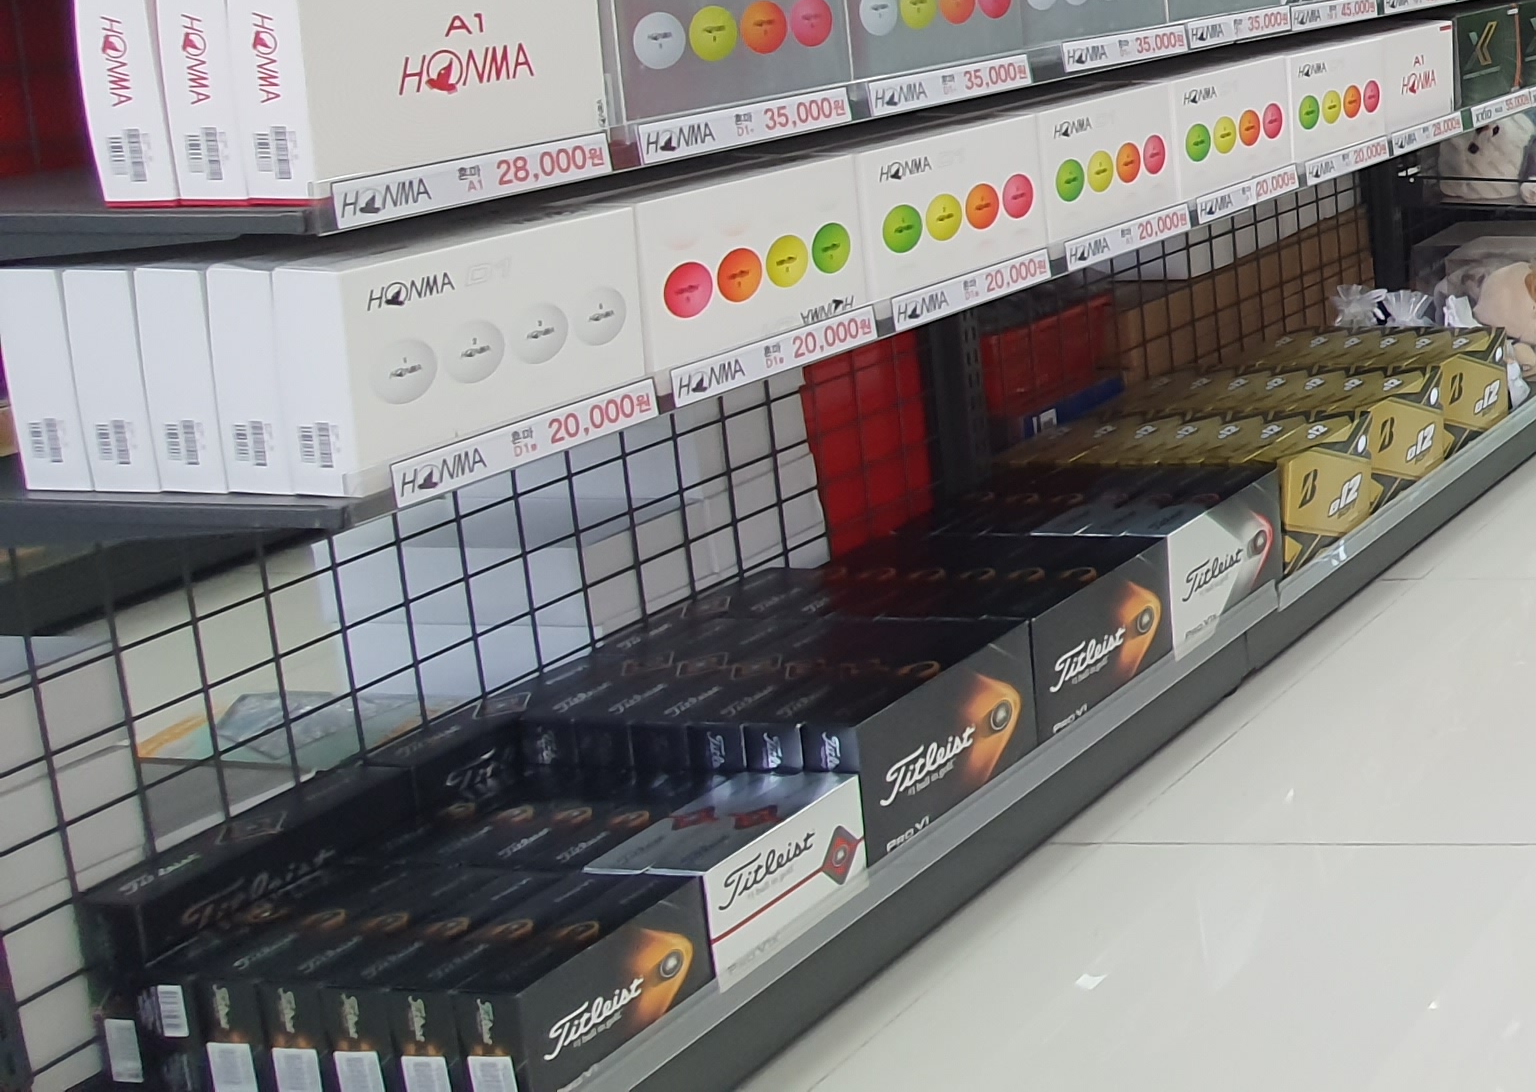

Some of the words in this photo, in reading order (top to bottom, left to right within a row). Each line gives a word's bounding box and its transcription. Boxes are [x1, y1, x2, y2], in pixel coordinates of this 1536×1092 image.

[444, 12, 486, 38] A1
[1247, 11, 1289, 32] 35,000원
[1340, 0, 1376, 18] 45,000원
[99, 14, 133, 108] HONMA
[180, 13, 211, 106] HONMA
[251, 12, 281, 104] HONMA
[399, 42, 535, 96] HONMA
[1067, 43, 1108, 65] HONMA
[1135, 31, 1185, 55] 35,000원
[1413, 55, 1425, 67] A1
[874, 81, 928, 108] HONMA
[963, 60, 1028, 91] 35,000원
[1183, 86, 1217, 105] HONMA
[1401, 69, 1437, 96] HONMA
[645, 120, 716, 156] HONMA
[763, 96, 846, 132] 35,000원
[1053, 117, 1092, 139] HONMA
[879, 154, 933, 183] HONMA
[1353, 144, 1387, 165] 20,000원
[340, 177, 433, 220] HONMA
[496, 143, 605, 188] 28,000원
[1255, 172, 1297, 198] 20,000원
[1138, 210, 1188, 240] 20,000원
[366, 271, 456, 312] HONMA
[896, 292, 951, 324] HONMA
[985, 258, 1047, 294] 20,000원
[677, 358, 746, 398] HONMA
[792, 317, 872, 360] 20,000원
[400, 445, 488, 498] HONMA
[547, 392, 653, 445] 20,000원
[1181, 546, 1244, 603] Titleist
[1049, 624, 1127, 693] Titleist
[880, 723, 976, 808] Titleist
[886, 826, 914, 853] PRO
[719, 831, 815, 910] Titleist
[544, 975, 645, 1062] Titleist
